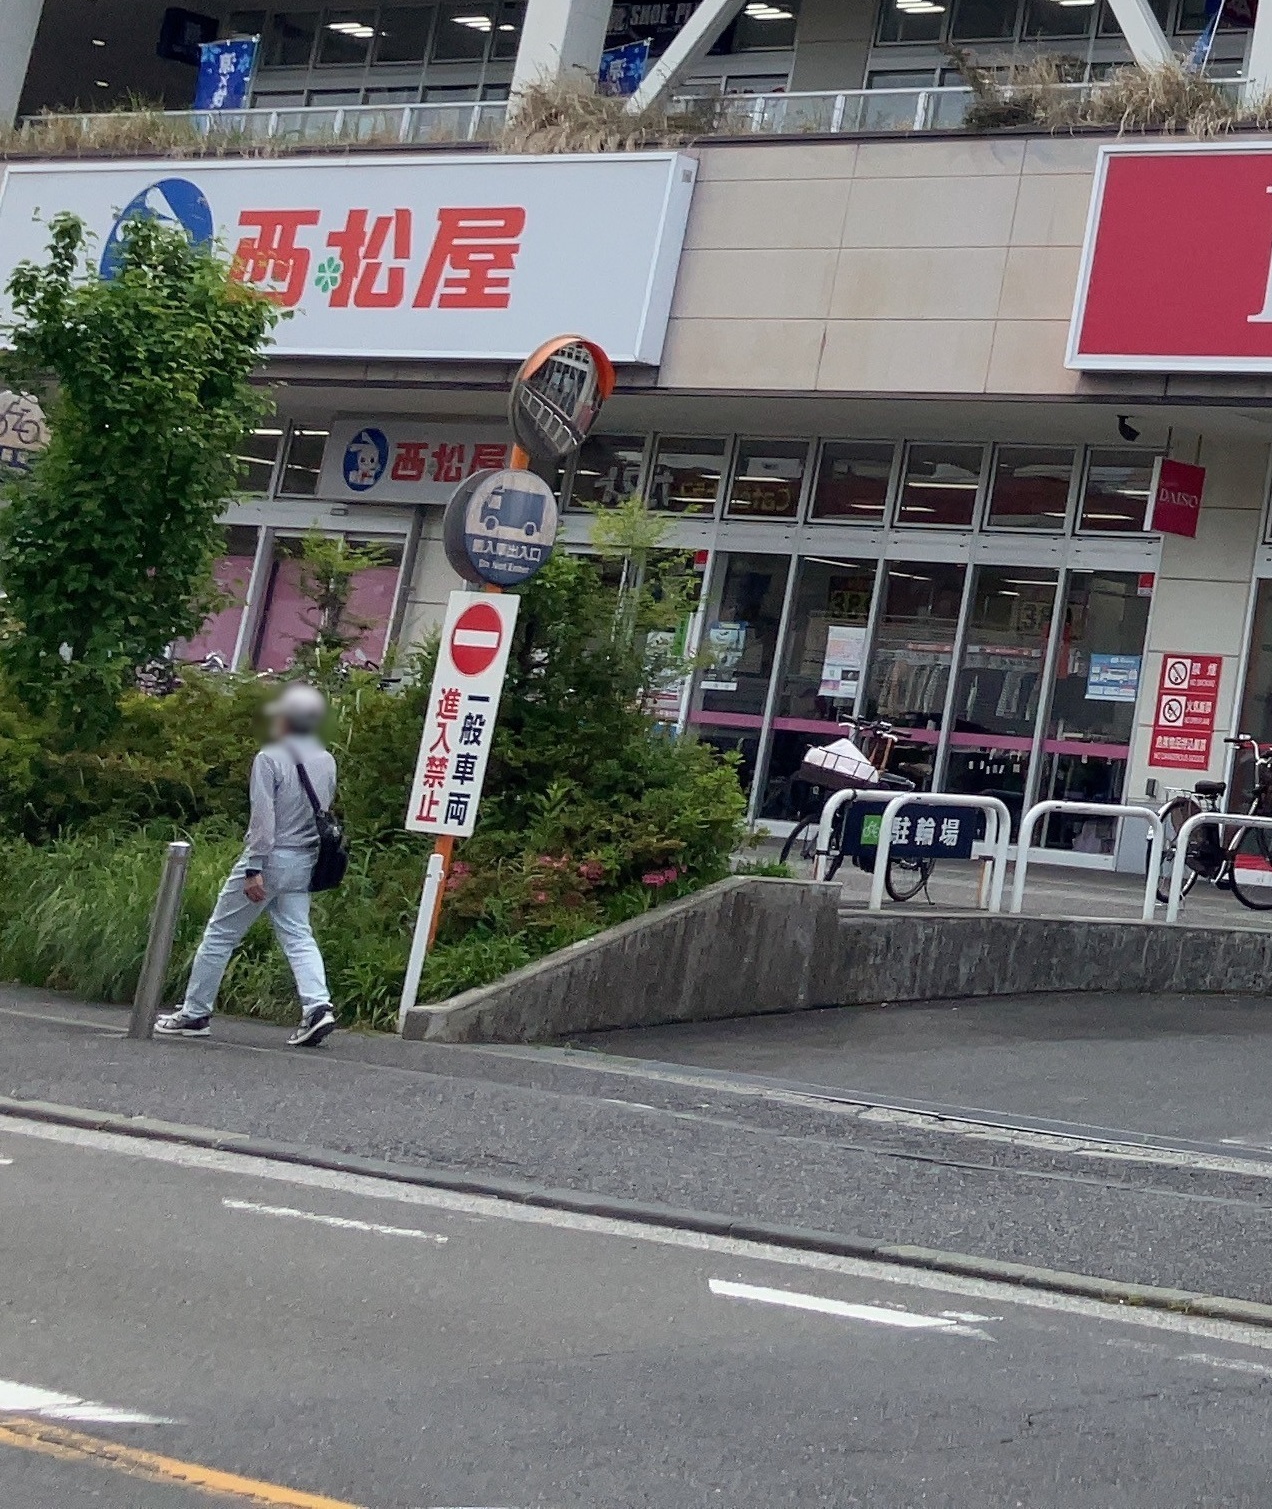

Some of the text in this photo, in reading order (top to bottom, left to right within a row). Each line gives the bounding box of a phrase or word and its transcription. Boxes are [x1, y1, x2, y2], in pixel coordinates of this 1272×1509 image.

[230, 206, 526, 309] 西松屋
[1159, 487, 1199, 508] DAISO
[415, 686, 463, 825] 進入禁止
[443, 693, 492, 827] 一般車両
[889, 816, 961, 847] 駐輪場
